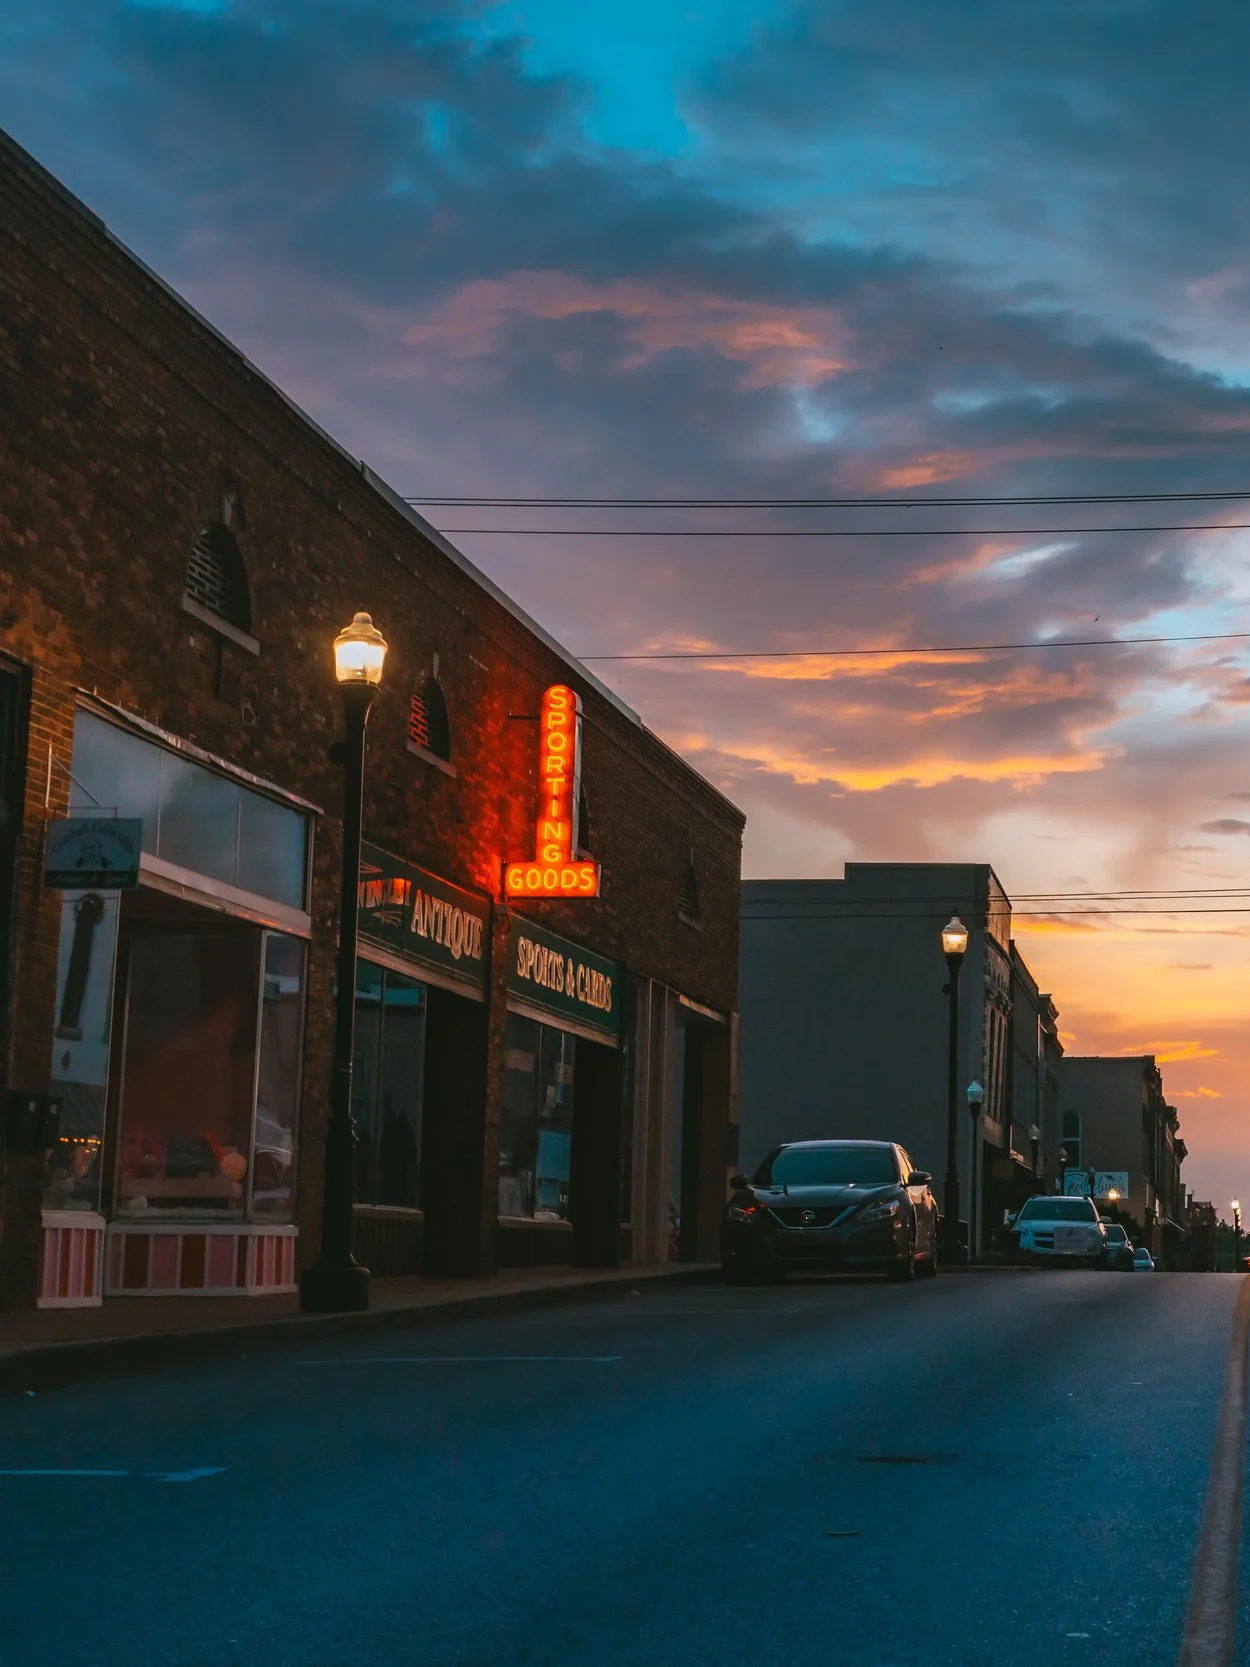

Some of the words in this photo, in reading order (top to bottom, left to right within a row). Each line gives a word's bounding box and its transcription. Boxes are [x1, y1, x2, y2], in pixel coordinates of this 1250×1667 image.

[542, 687, 568, 863] SPORTING
[508, 868, 594, 889] GOODS
[411, 889, 483, 960] ANTIQUE
[517, 936, 564, 993] SPORTS
[565, 958, 575, 998] &
[576, 963, 612, 1012] CARDS
